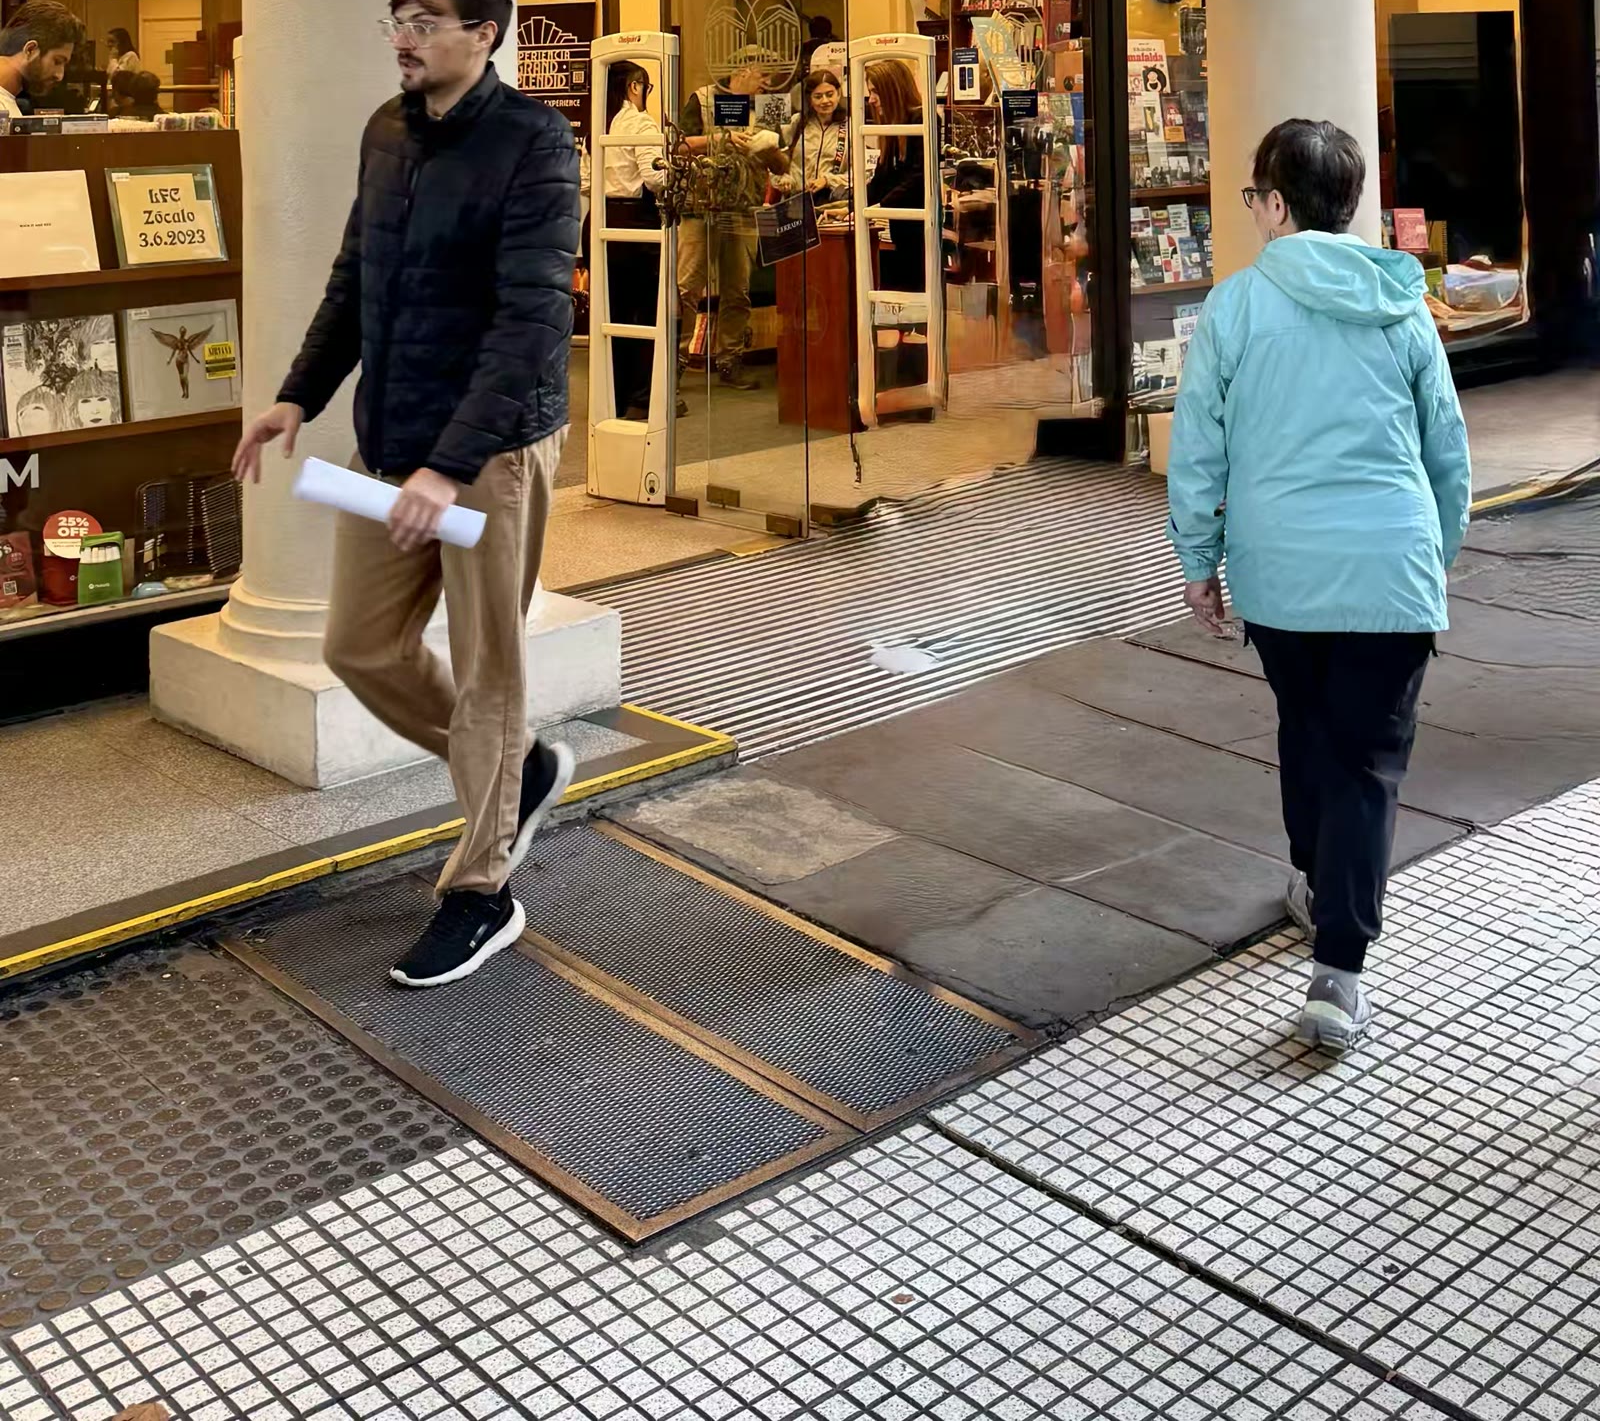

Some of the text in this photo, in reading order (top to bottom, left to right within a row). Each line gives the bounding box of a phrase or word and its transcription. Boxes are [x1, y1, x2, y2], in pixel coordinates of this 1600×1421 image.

[518, 50, 571, 61] PERIENCIA
[517, 74, 567, 89] PLENDID
[148, 187, 181, 204] LFC
[143, 209, 196, 226] Zócalo
[139, 229, 206, 248] 3.6.2023
[58, 517, 90, 527] 25%
[57, 527, 89, 537] OFF
